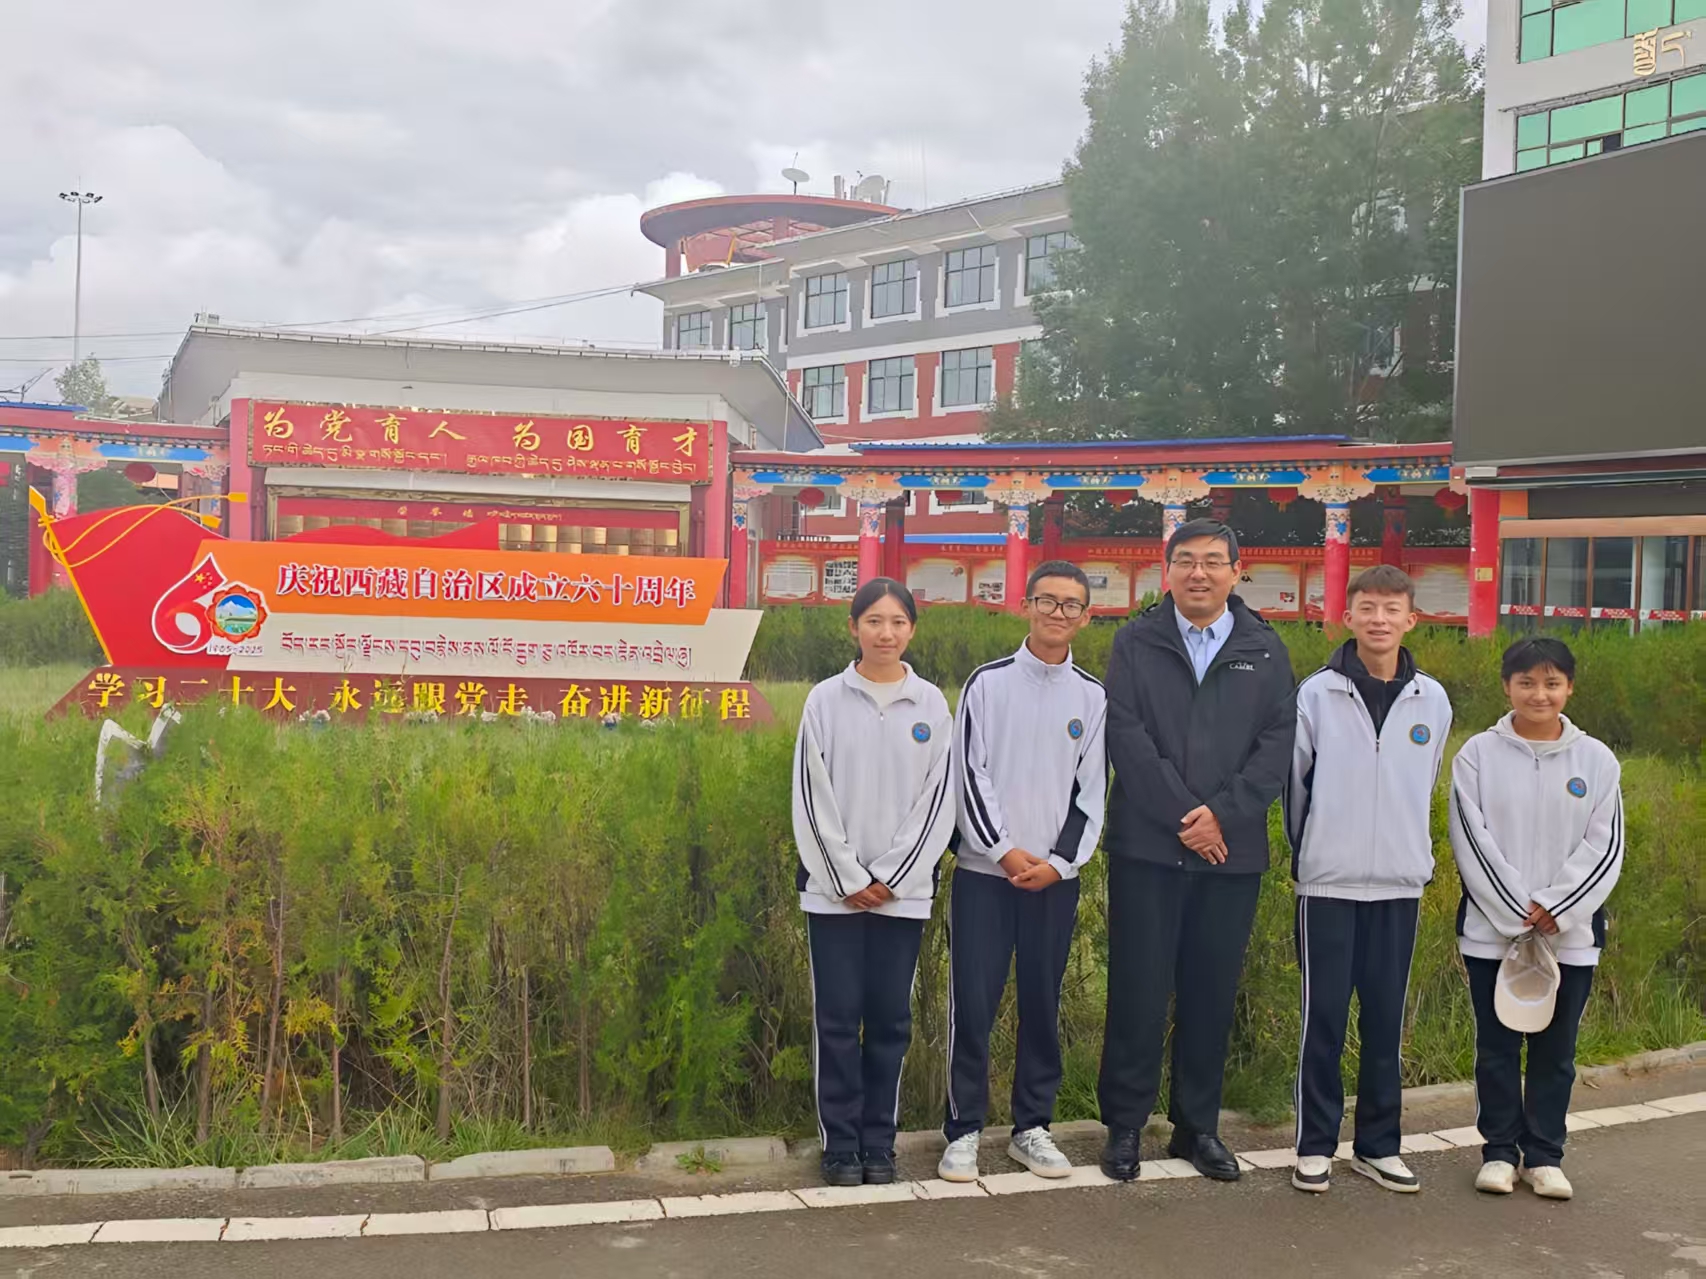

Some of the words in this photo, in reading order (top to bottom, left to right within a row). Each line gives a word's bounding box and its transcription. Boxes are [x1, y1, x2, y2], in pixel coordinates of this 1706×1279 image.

[263, 406, 467, 443] 为党育人
[512, 419, 700, 458] 为国育才
[276, 563, 696, 608] 庆祝西藏自治区成立六十周年
[87, 672, 297, 712] 学习二十大
[557, 683, 751, 720] 奋进新征程
